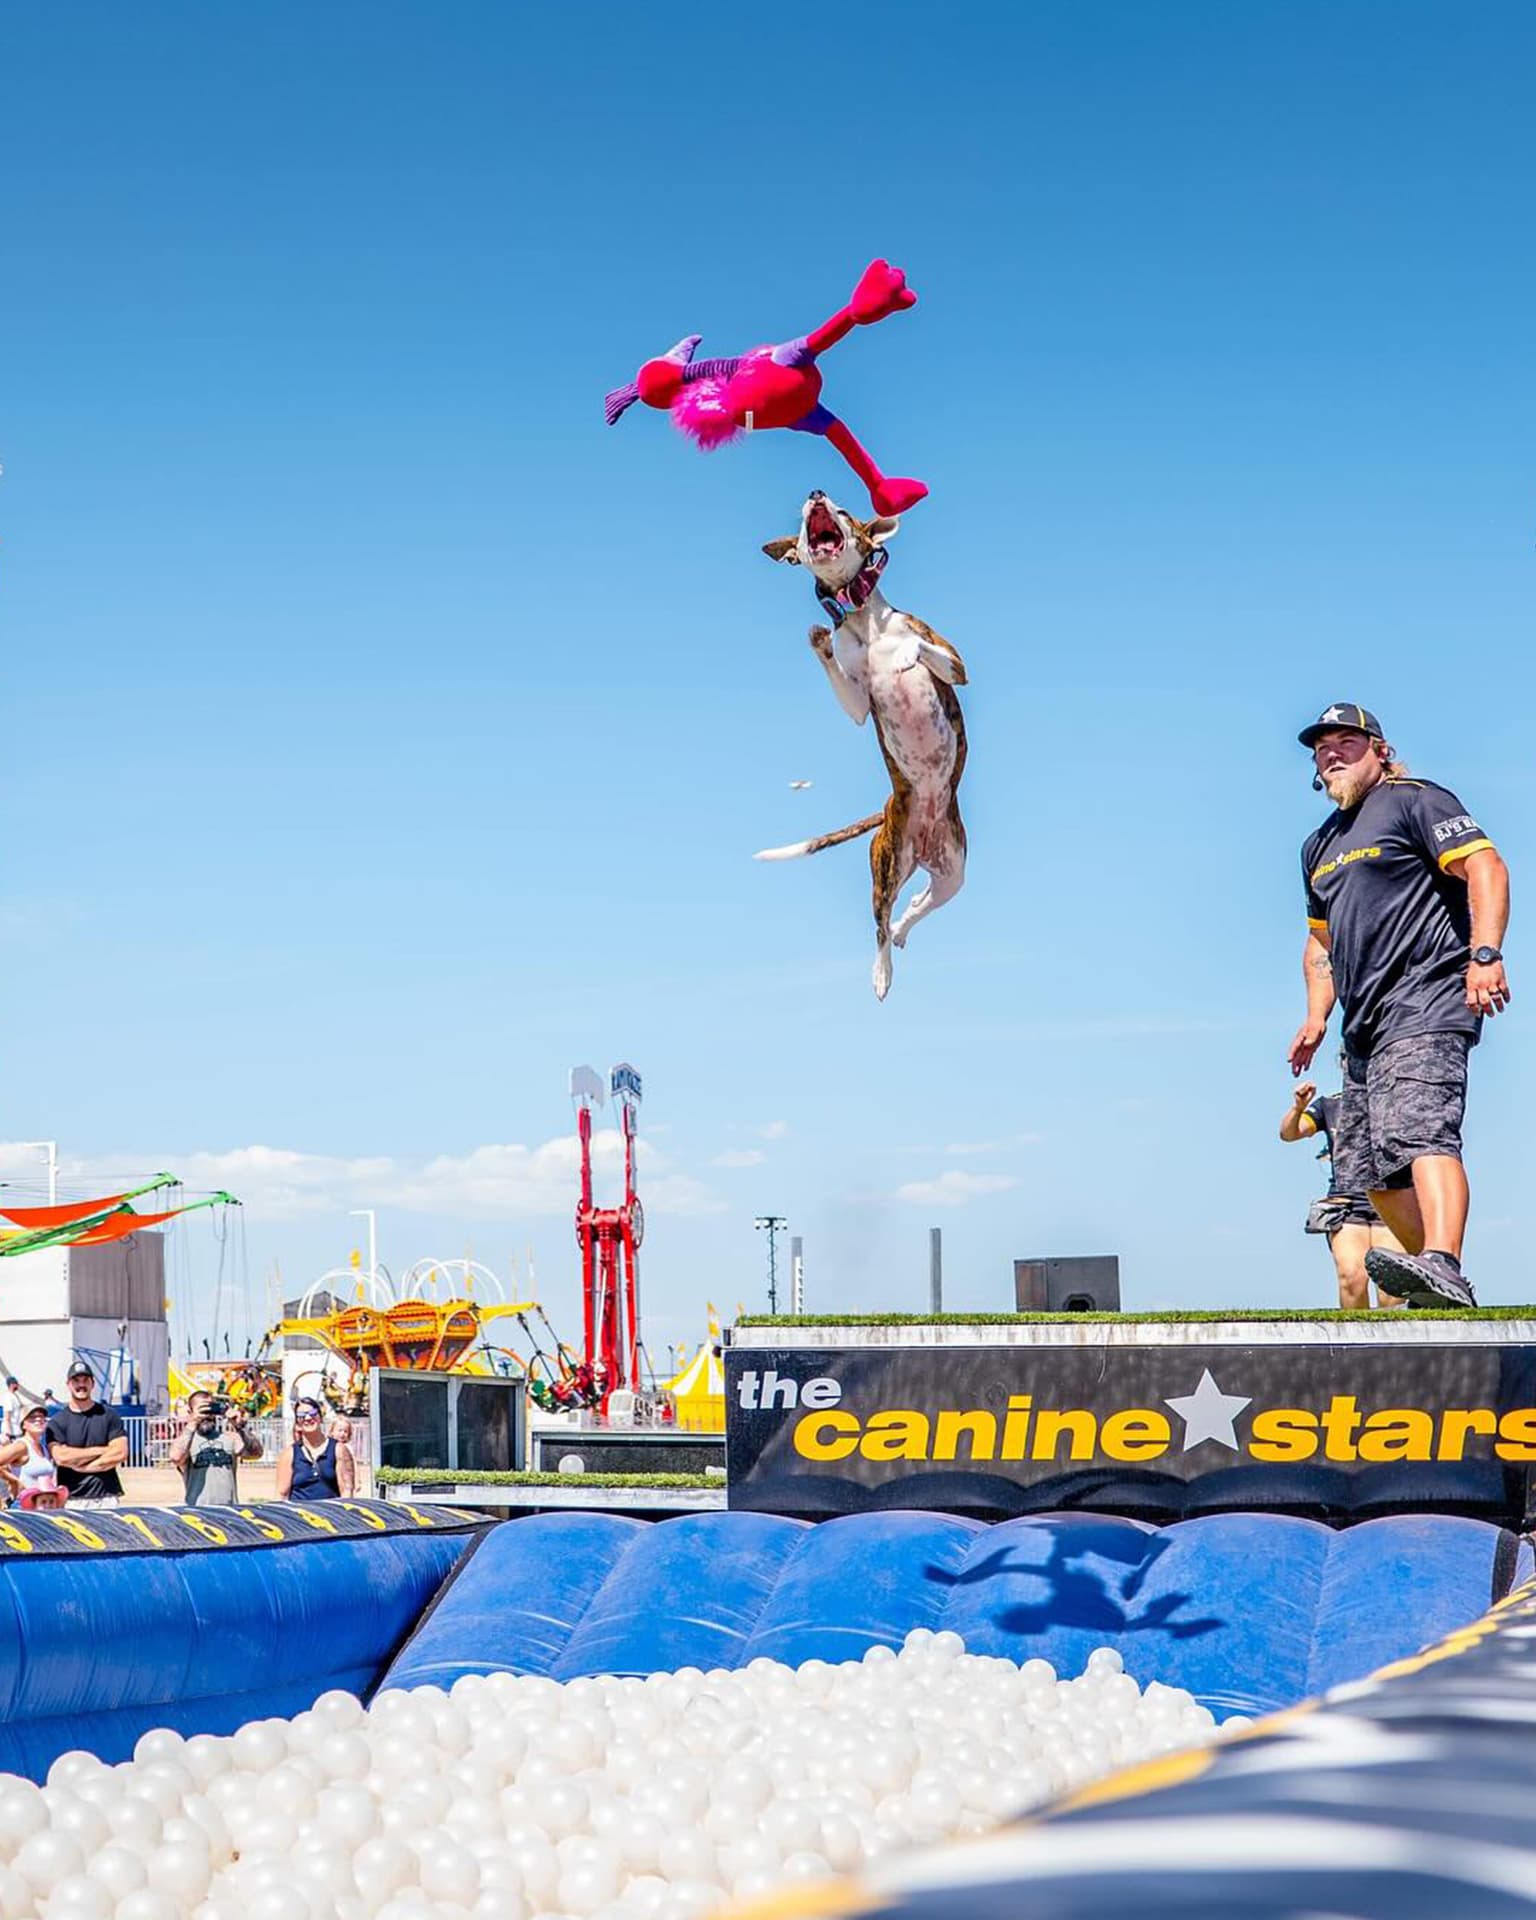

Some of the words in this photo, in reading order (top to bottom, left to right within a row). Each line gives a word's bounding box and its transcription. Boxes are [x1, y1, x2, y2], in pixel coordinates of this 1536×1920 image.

[1342, 847, 1382, 865] stars
[736, 1370, 843, 1410] the
[793, 1394, 1172, 1463] canine
[1247, 1395, 1536, 1463] stars
[51, 1515, 106, 1549] 8
[120, 1514, 164, 1548] 7
[180, 1514, 229, 1545] 6
[239, 1508, 285, 1541] 5
